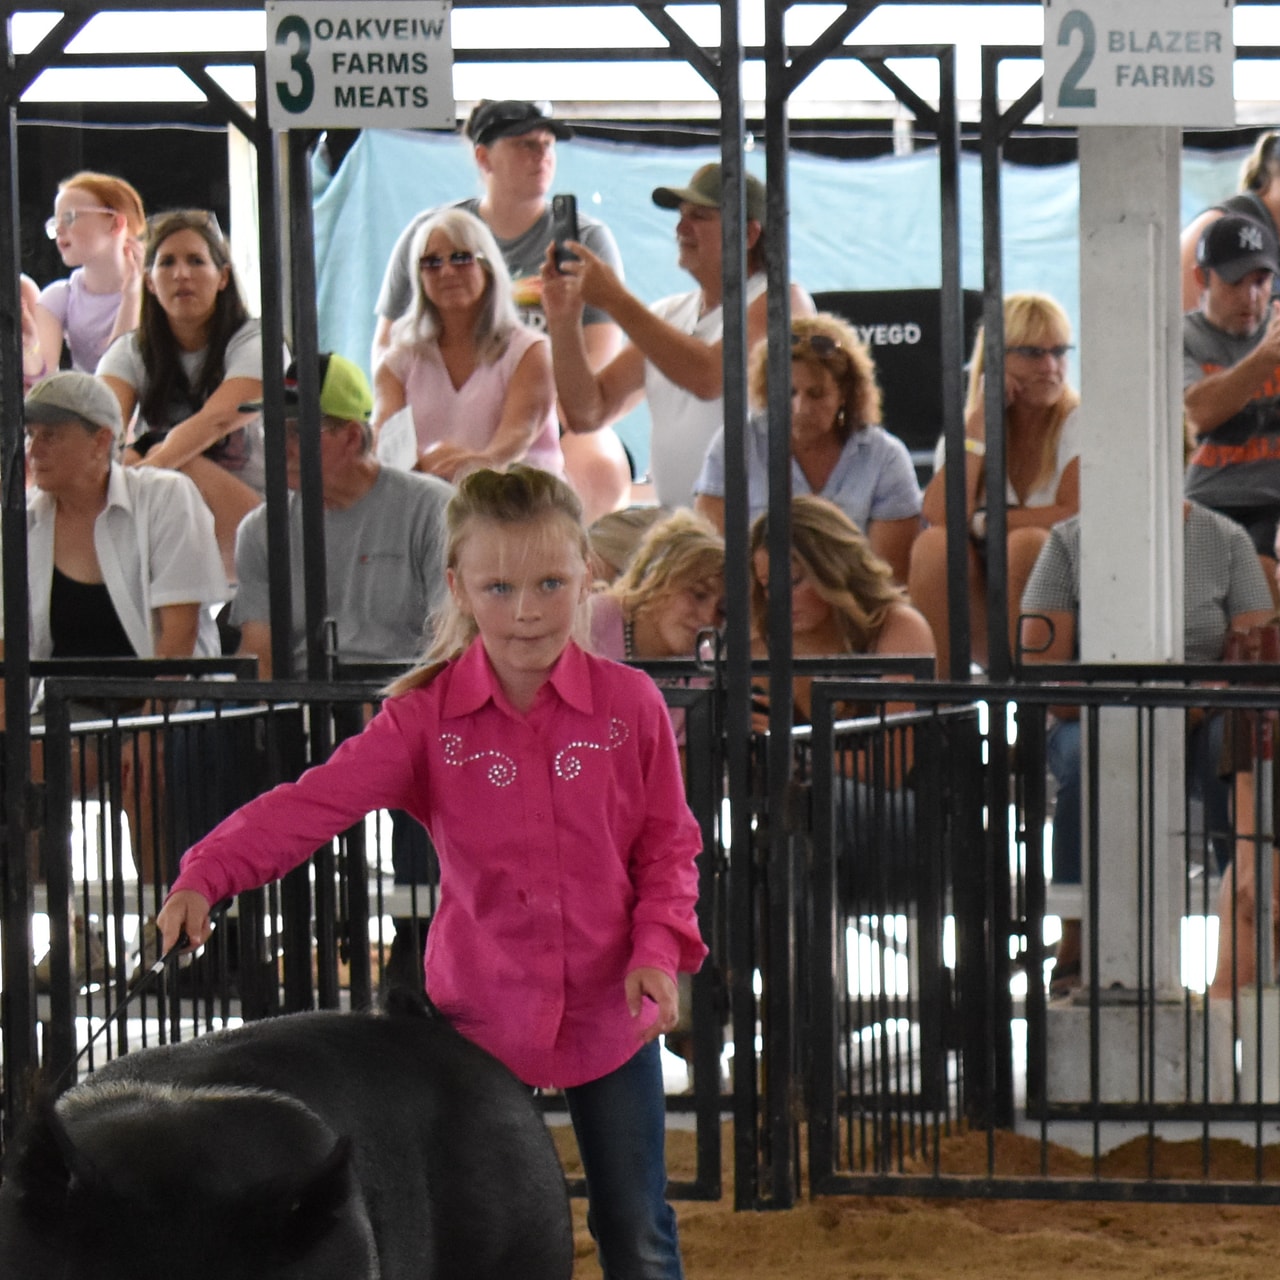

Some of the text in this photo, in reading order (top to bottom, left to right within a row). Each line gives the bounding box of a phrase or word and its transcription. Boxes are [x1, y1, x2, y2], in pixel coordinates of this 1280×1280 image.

[314, 18, 445, 41] OAKVEIW
[1107, 30, 1223, 54] BLAZER
[275, 14, 315, 114] 3
[332, 52, 429, 75] FARMS
[1057, 9, 1097, 108] 2
[1115, 65, 1216, 88] FARMS
[334, 86, 430, 109] MEATS
